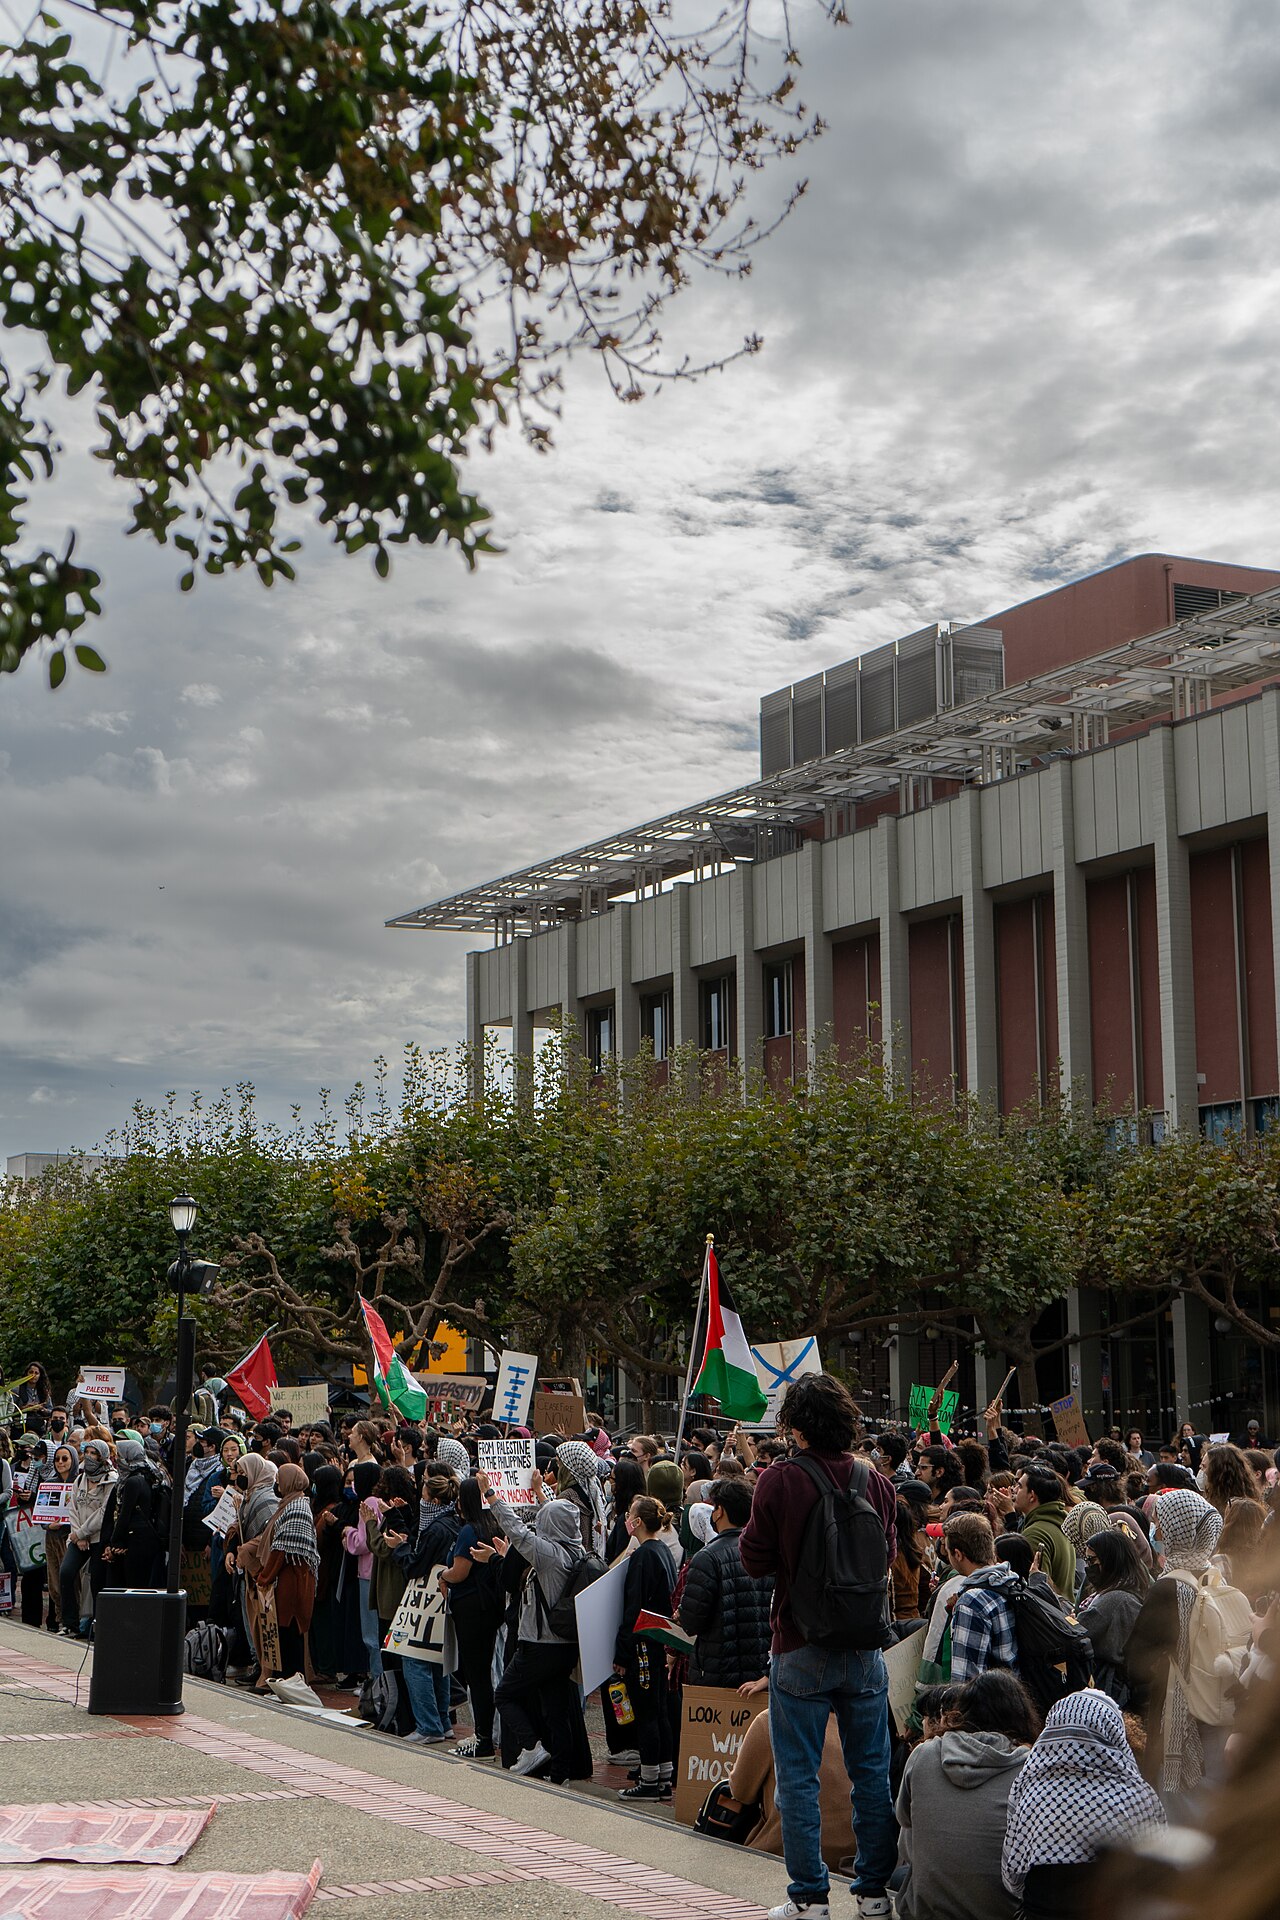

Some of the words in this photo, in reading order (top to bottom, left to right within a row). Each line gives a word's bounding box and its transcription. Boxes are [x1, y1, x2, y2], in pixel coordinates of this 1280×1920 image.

[95, 1374, 110, 1382] FREE
[86, 1386, 116, 1394] PALESTINE
[272, 1391, 287, 1401] WE
[429, 1400, 453, 1413] FREE
[1053, 1396, 1074, 1414] STOP
[544, 1411, 573, 1428] NOW
[478, 1441, 495, 1456] FROM
[497, 1440, 531, 1455] PALESTINE
[486, 1456, 497, 1470] THE
[498, 1455, 532, 1469] PHILIPPINES
[487, 1471, 503, 1487] STOP
[504, 1470, 520, 1486] THE
[507, 1488, 535, 1504] MACHINE
[396, 1611, 444, 1653] This
[688, 1706, 722, 1724] LOOK
[730, 1709, 751, 1727] UP
[687, 1755, 734, 1783] PHOS
